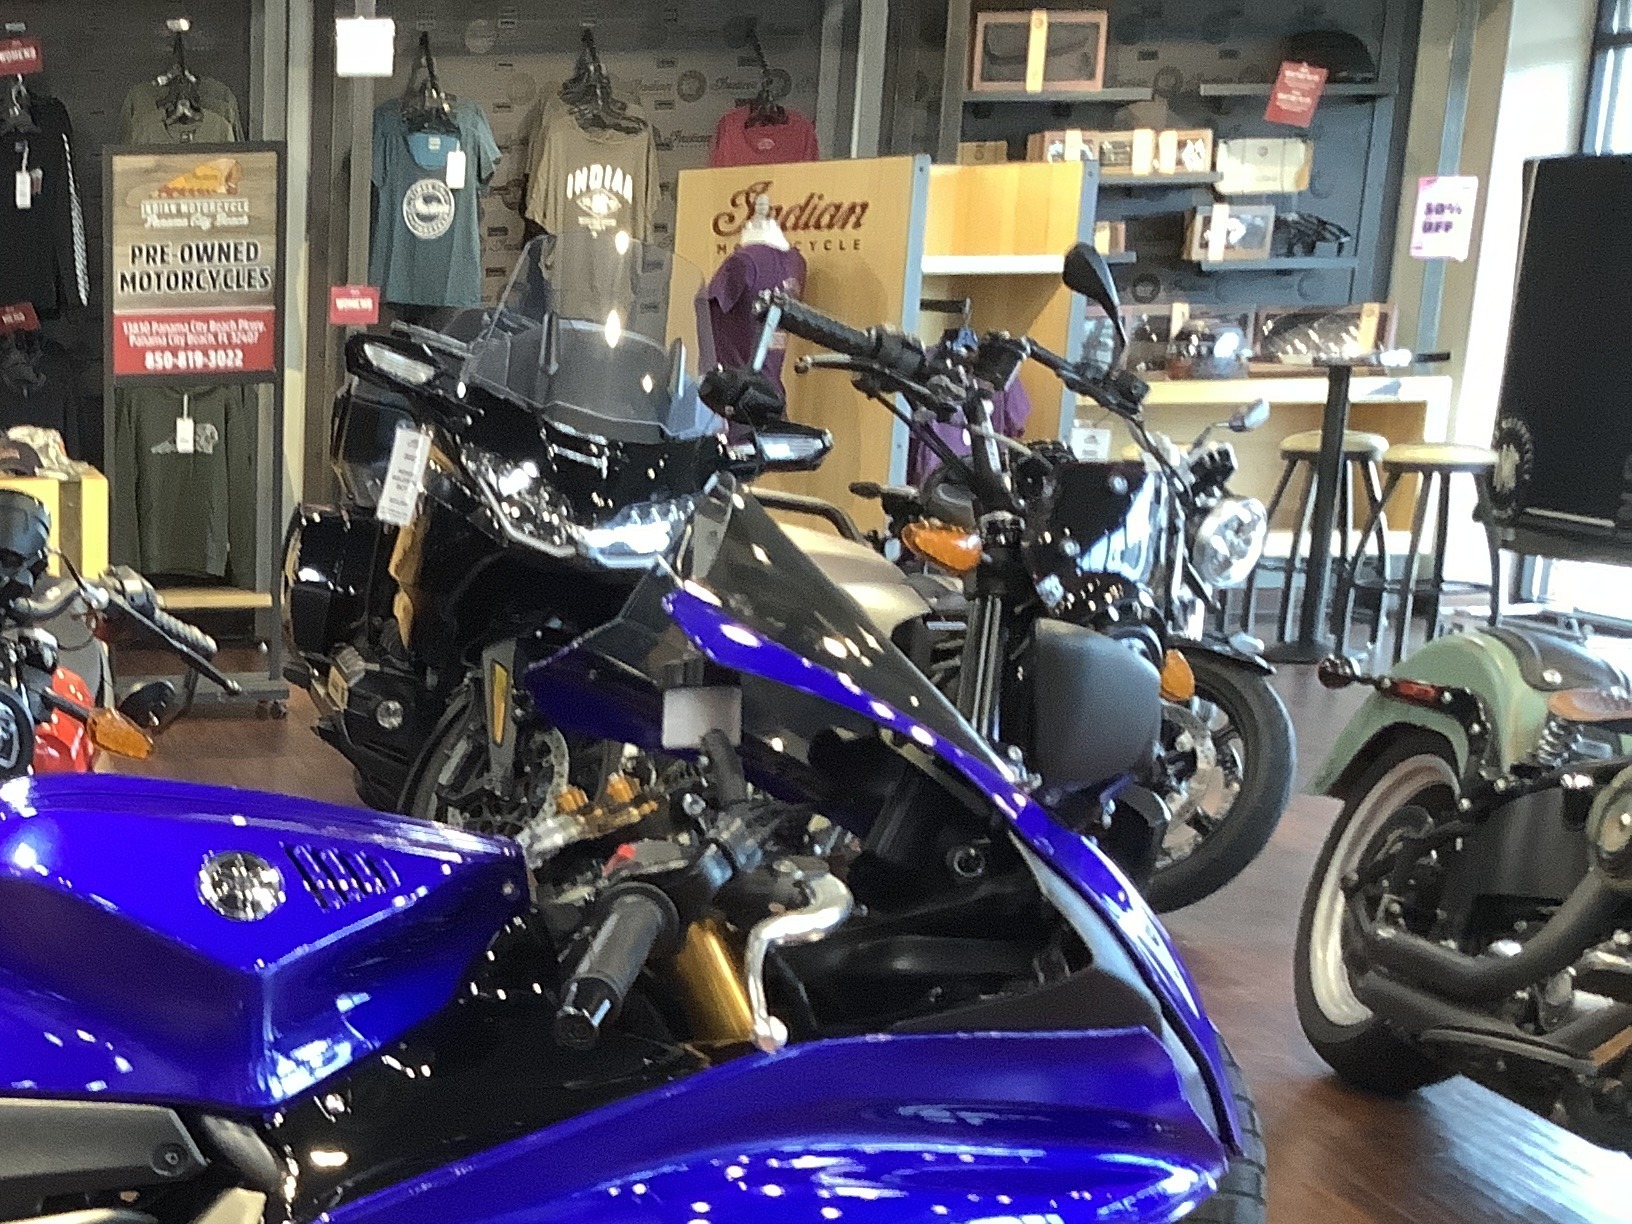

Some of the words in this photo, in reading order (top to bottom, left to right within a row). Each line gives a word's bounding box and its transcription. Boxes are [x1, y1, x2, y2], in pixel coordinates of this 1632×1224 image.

[141, 201, 177, 216] INDIAN
[180, 199, 250, 214] MOTORCYCLE
[711, 180, 869, 237] Indian
[130, 241, 260, 266] PRE-OWNED
[119, 267, 272, 293] MOTORCYCLES
[144, 349, 244, 370] 850-819-3022
